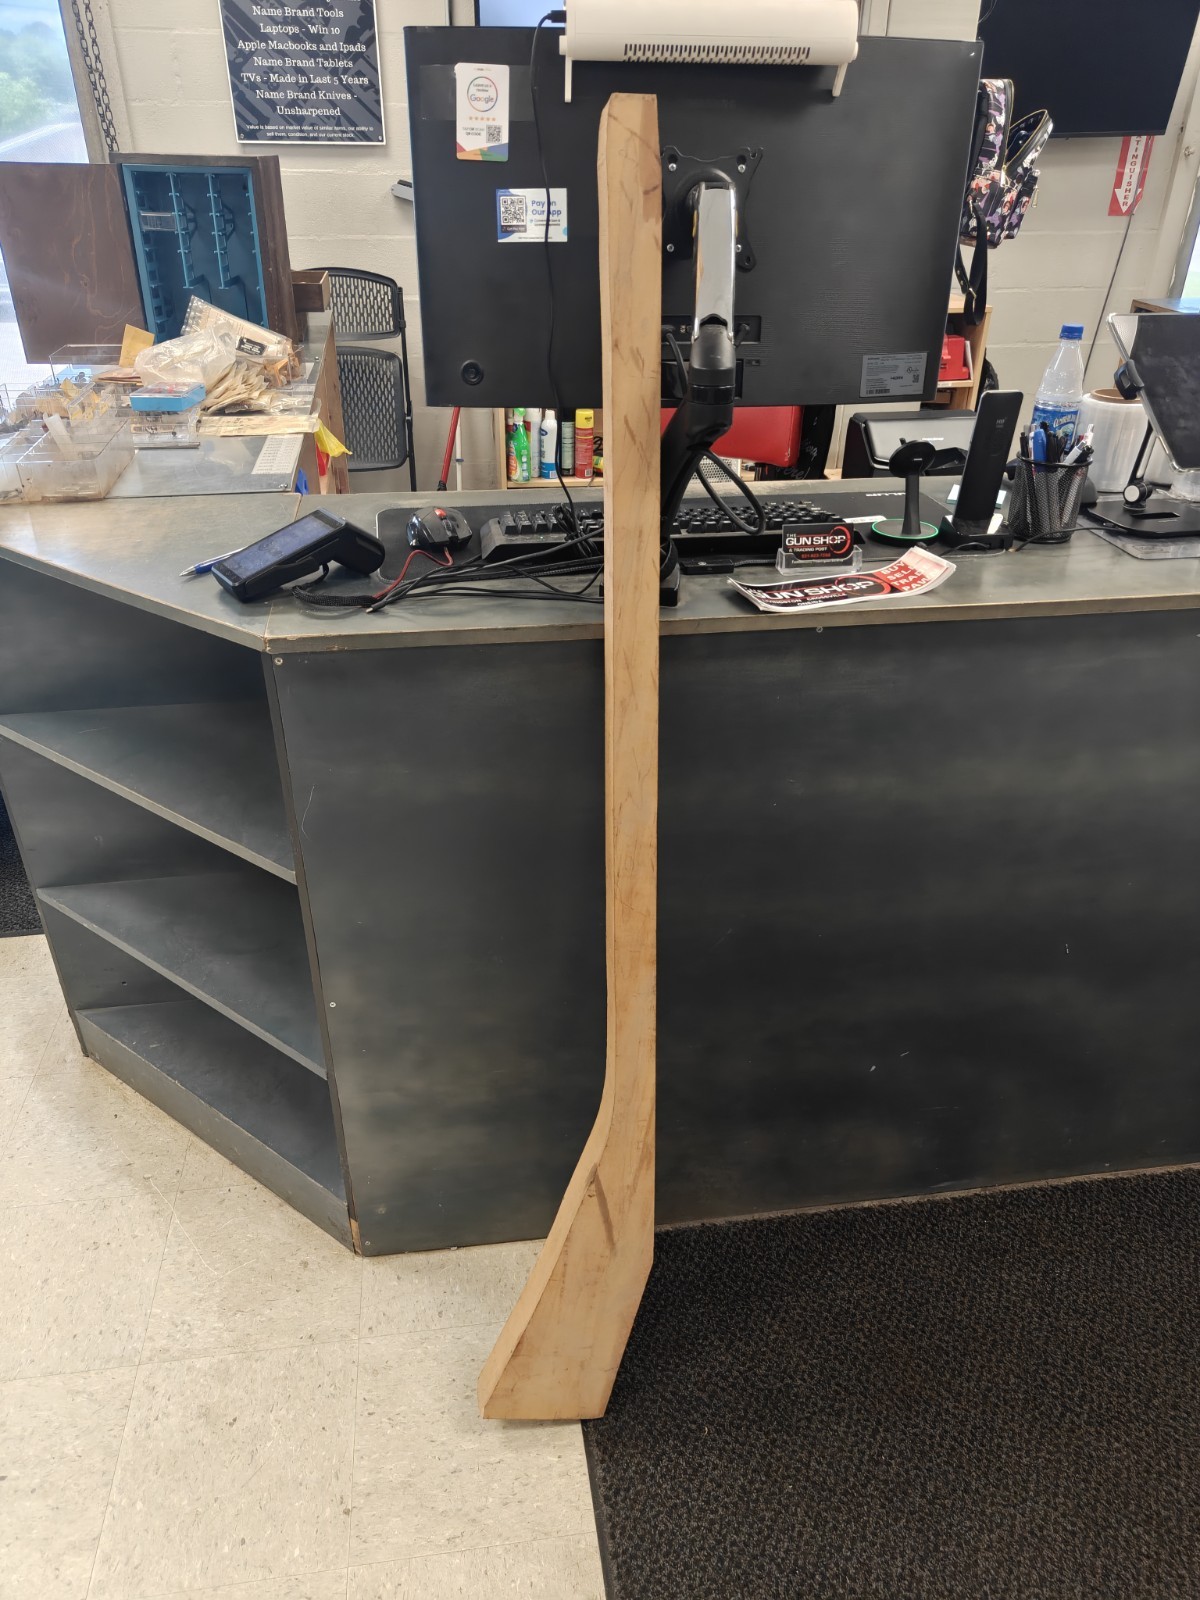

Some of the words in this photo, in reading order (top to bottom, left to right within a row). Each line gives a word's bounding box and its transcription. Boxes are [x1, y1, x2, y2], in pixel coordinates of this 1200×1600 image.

[252, 6, 282, 16] Name
[284, 6, 315, 17] Brand
[316, 8, 344, 18] Tools
[260, 23, 299, 34] Laptops
[308, 24, 329, 34] Win
[331, 27, 340, 35] 10
[237, 40, 266, 51] Apple
[268, 41, 317, 51] Macbooks
[319, 42, 338, 51] and
[339, 43, 366, 54] Ipads
[253, 57, 282, 67] Name
[285, 57, 315, 67] Brand
[316, 58, 353, 68] Tablets
[240, 73, 262, 83] TVs
[269, 74, 296, 83] Made
[298, 74, 308, 83] in
[309, 75, 332, 84] Last
[334, 77, 339, 85] 5
[340, 75, 369, 85] Years
[255, 90, 285, 99] Name
[287, 90, 317, 100] Brand
[319, 90, 352, 100] Knives
[470, 93, 494, 104] Google
[276, 106, 342, 117] Unsharpened
[531, 200, 545, 209] Pay
[549, 209, 561, 217] pp
[785, 537, 811, 546] GUN
[813, 535, 846, 545] SHOP
[881, 560, 904, 575] BUY
[804, 581, 874, 596] SHOP
